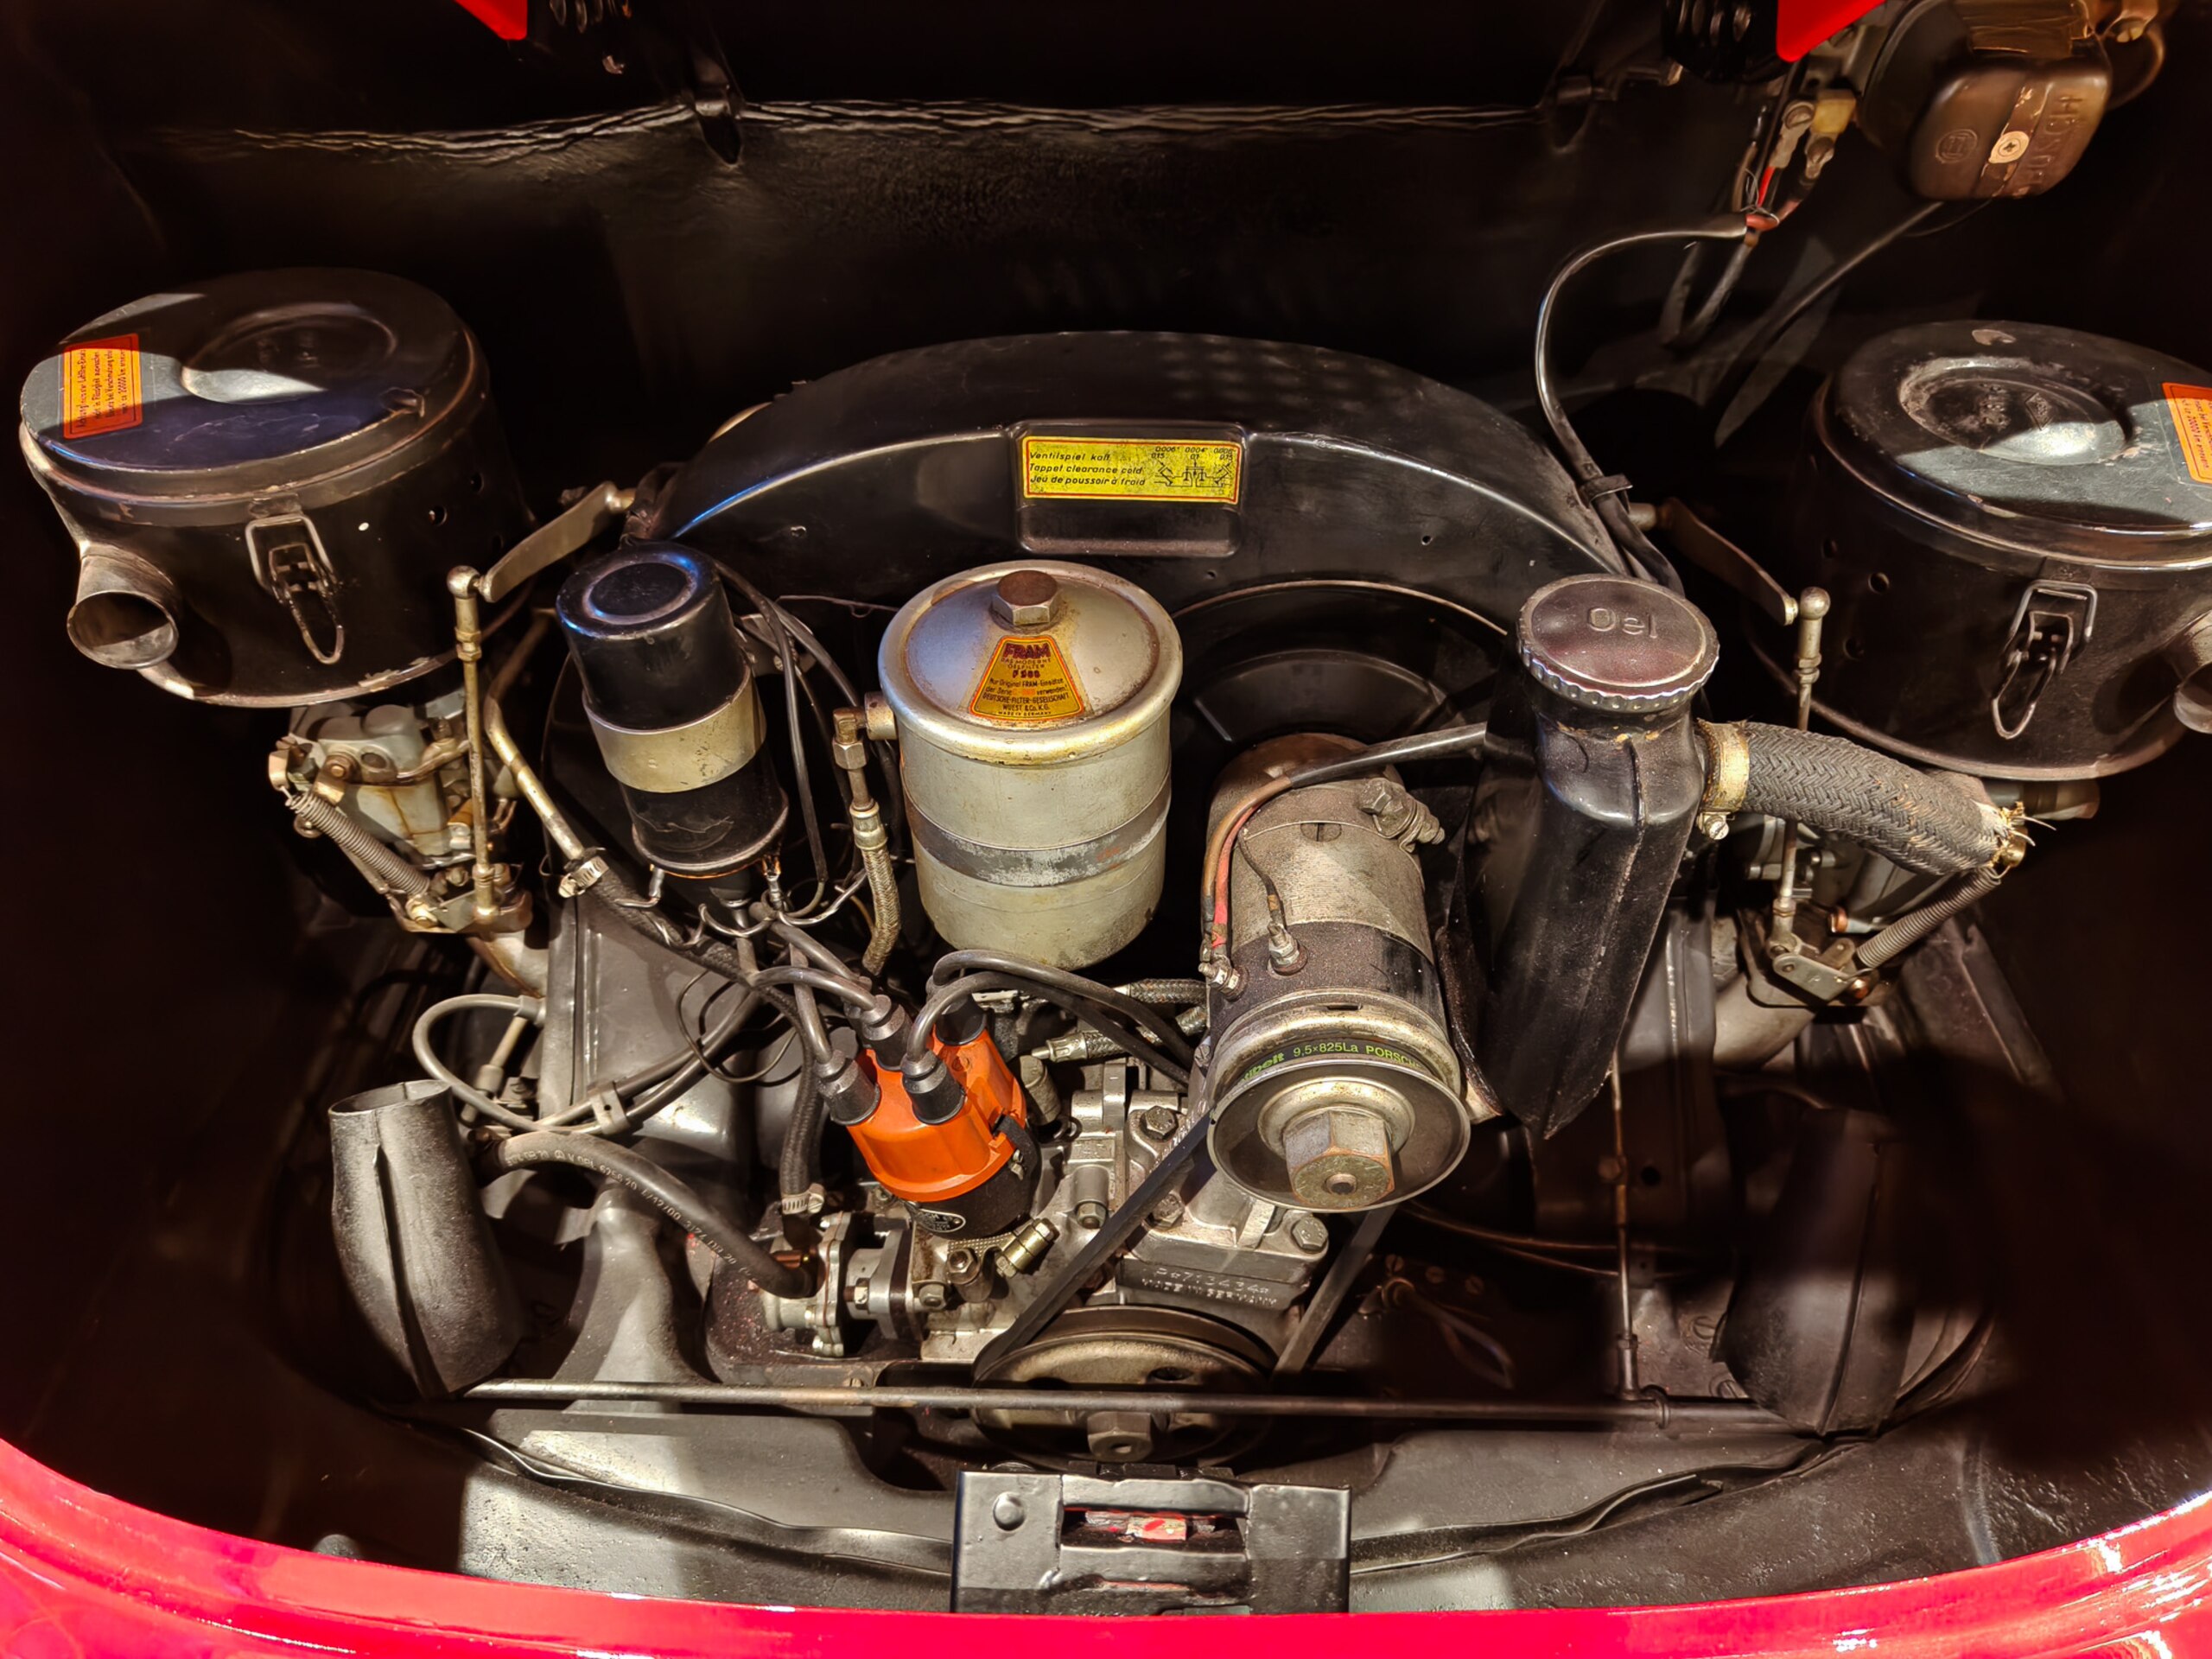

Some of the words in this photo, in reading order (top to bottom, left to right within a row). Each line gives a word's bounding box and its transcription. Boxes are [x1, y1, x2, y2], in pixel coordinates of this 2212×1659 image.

[1029, 452, 1086, 462] Ventilspiel
[1029, 463, 1063, 473] Tappet
[1065, 464, 1118, 474] clearance
[1121, 466, 1143, 474] cold
[1051, 475, 1064, 484] de
[1065, 476, 1110, 485] poussoir
[1121, 477, 1146, 486] froid
[1586, 607, 1658, 639] Oel
[1002, 643, 1052, 658] FRAM
[1365, 1045, 1421, 1069] PORSCH
